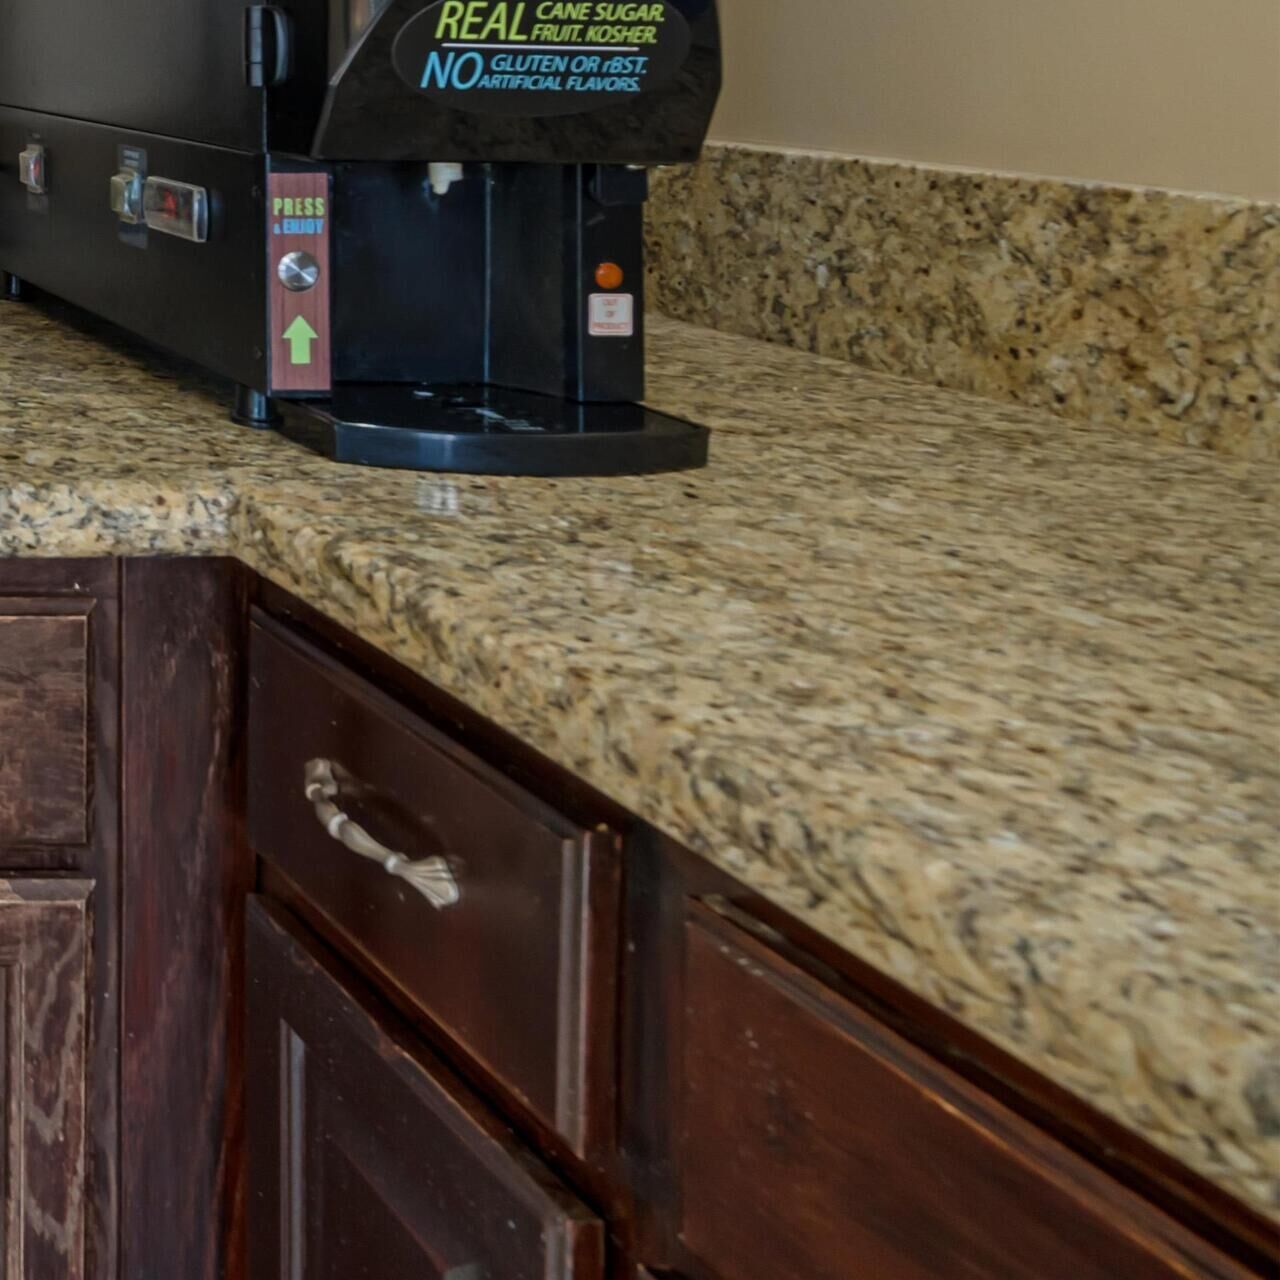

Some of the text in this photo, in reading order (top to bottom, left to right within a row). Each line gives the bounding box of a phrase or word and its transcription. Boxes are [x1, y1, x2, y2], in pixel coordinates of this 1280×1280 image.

[434, 0, 664, 41] REAL CANE SUGAR.
[530, 23, 658, 44] FRUIT. KOSHER.
[420, 50, 648, 90] NO GLUTEN OR rBST.
[478, 74, 641, 92] ARTIFICIAL FLAVORS.
[273, 197, 325, 216] PRESS
[283, 218, 324, 235] ENJOY
